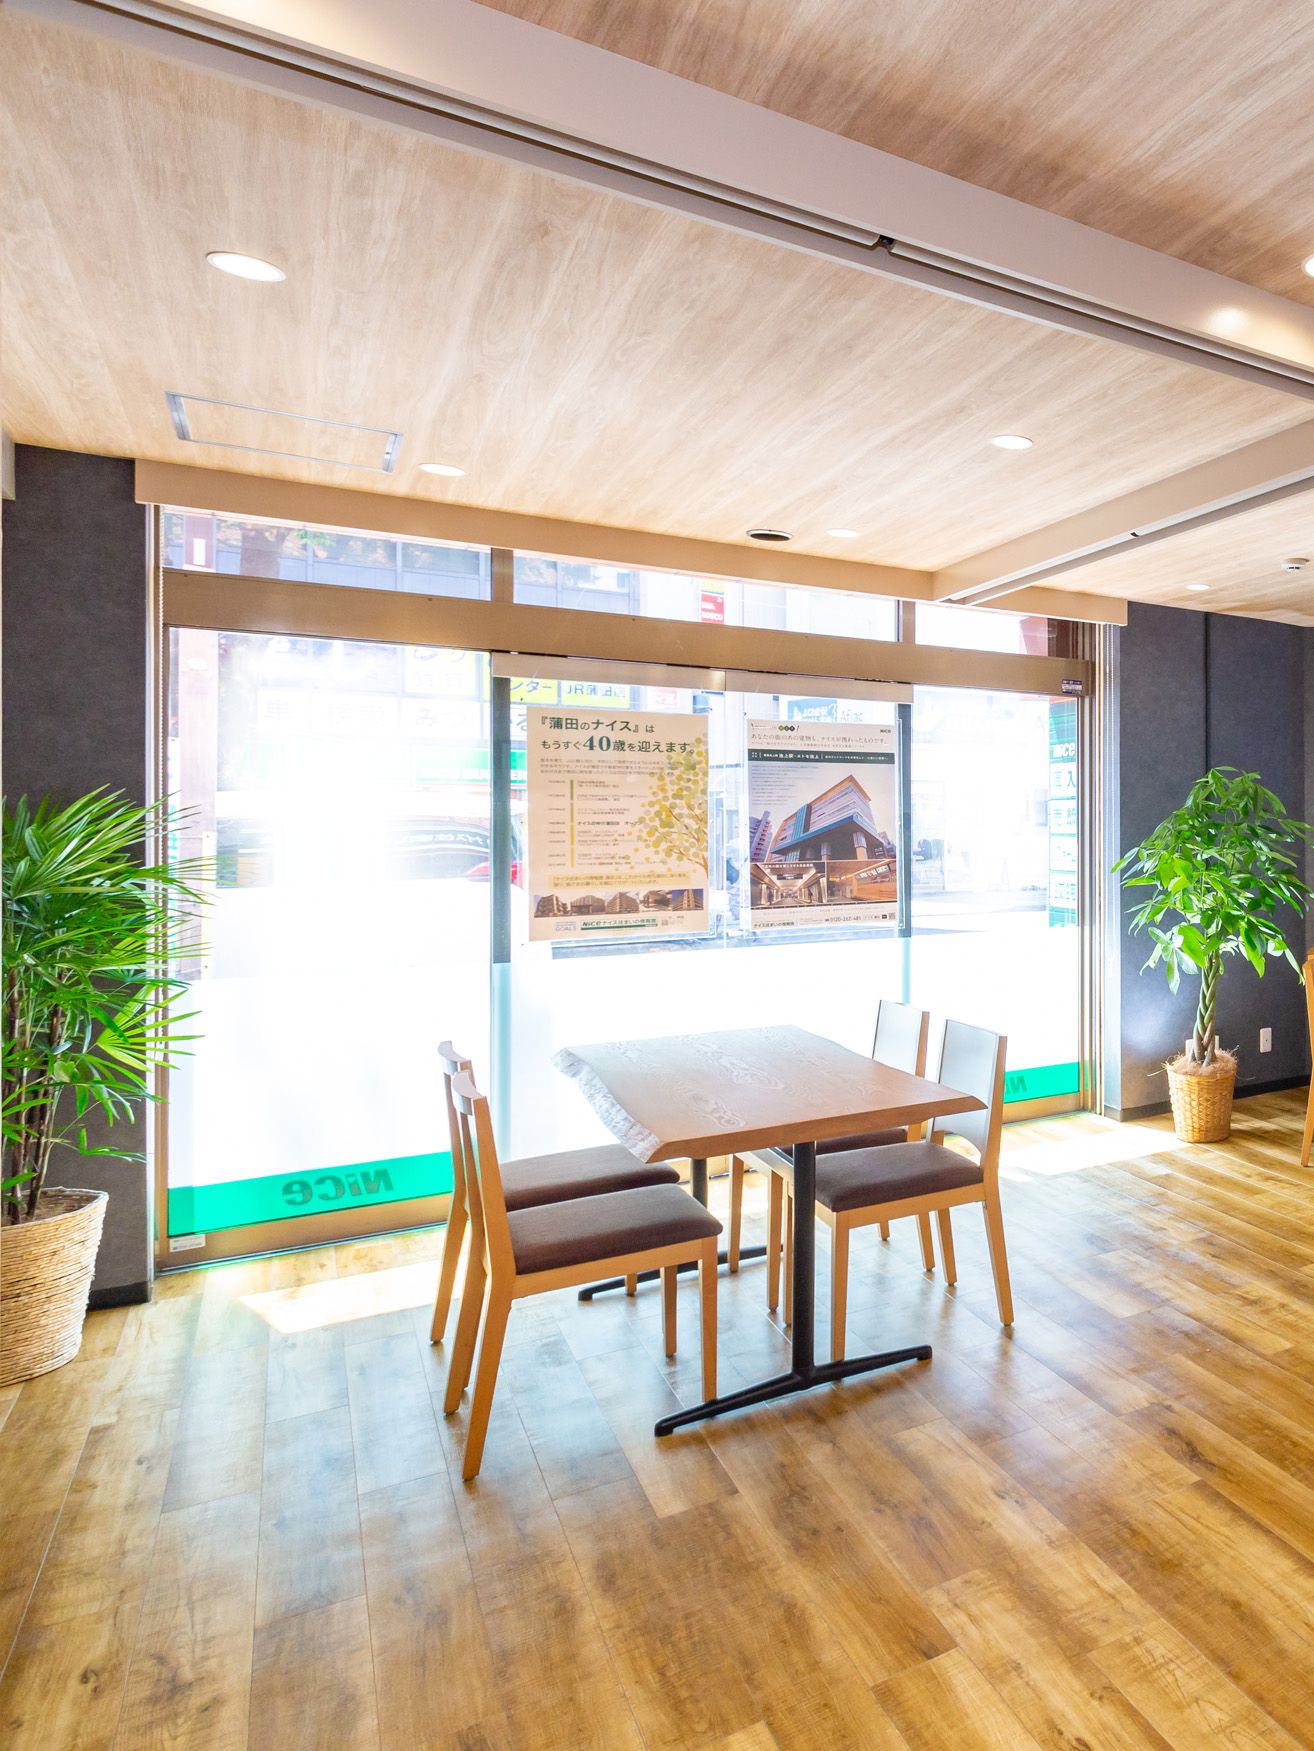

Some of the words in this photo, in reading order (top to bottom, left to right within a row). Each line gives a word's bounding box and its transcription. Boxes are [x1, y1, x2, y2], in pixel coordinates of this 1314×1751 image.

[541, 735, 695, 755] もうすぐ40歳を迎えます。
